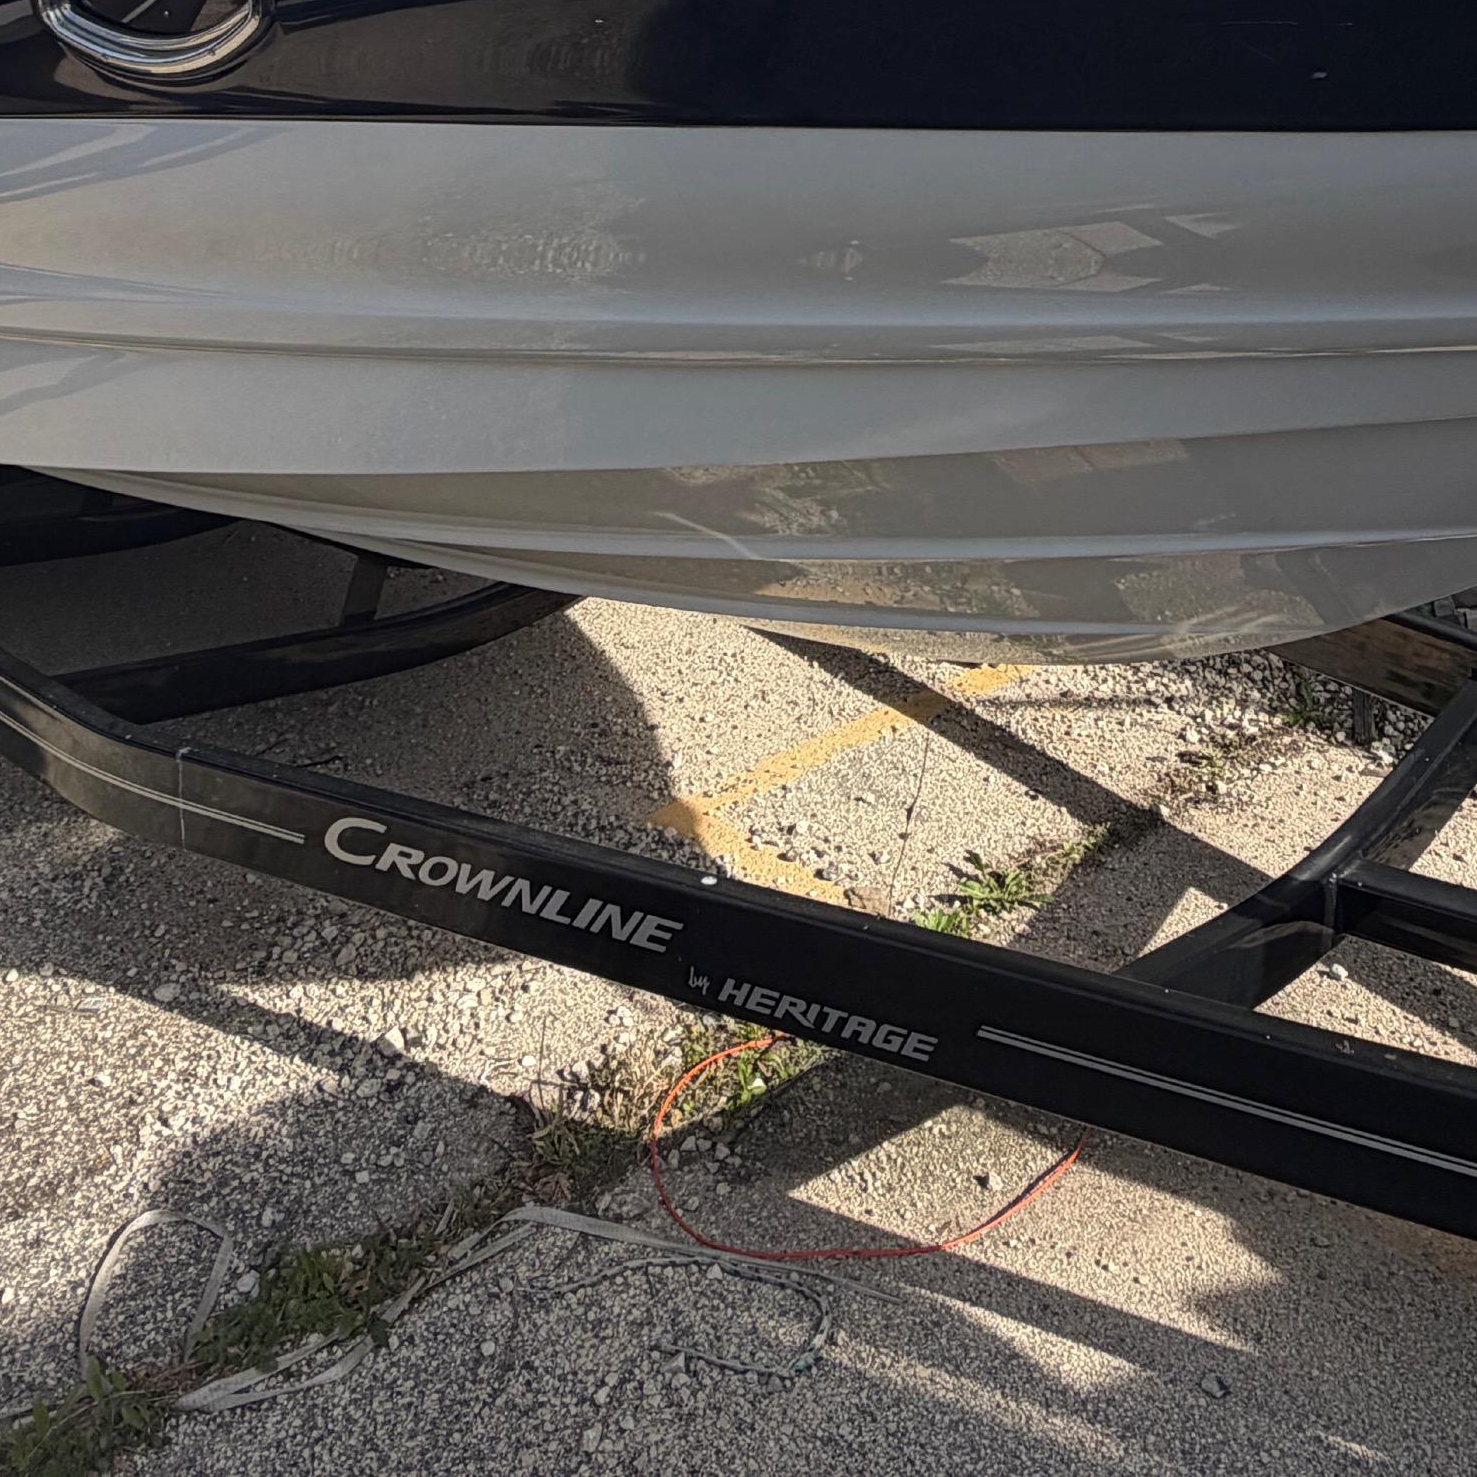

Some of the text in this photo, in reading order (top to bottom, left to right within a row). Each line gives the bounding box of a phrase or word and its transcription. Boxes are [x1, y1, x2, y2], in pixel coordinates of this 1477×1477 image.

[324, 817, 684, 953] CROWNLINE
[688, 965, 939, 1062] by HERITAGE
